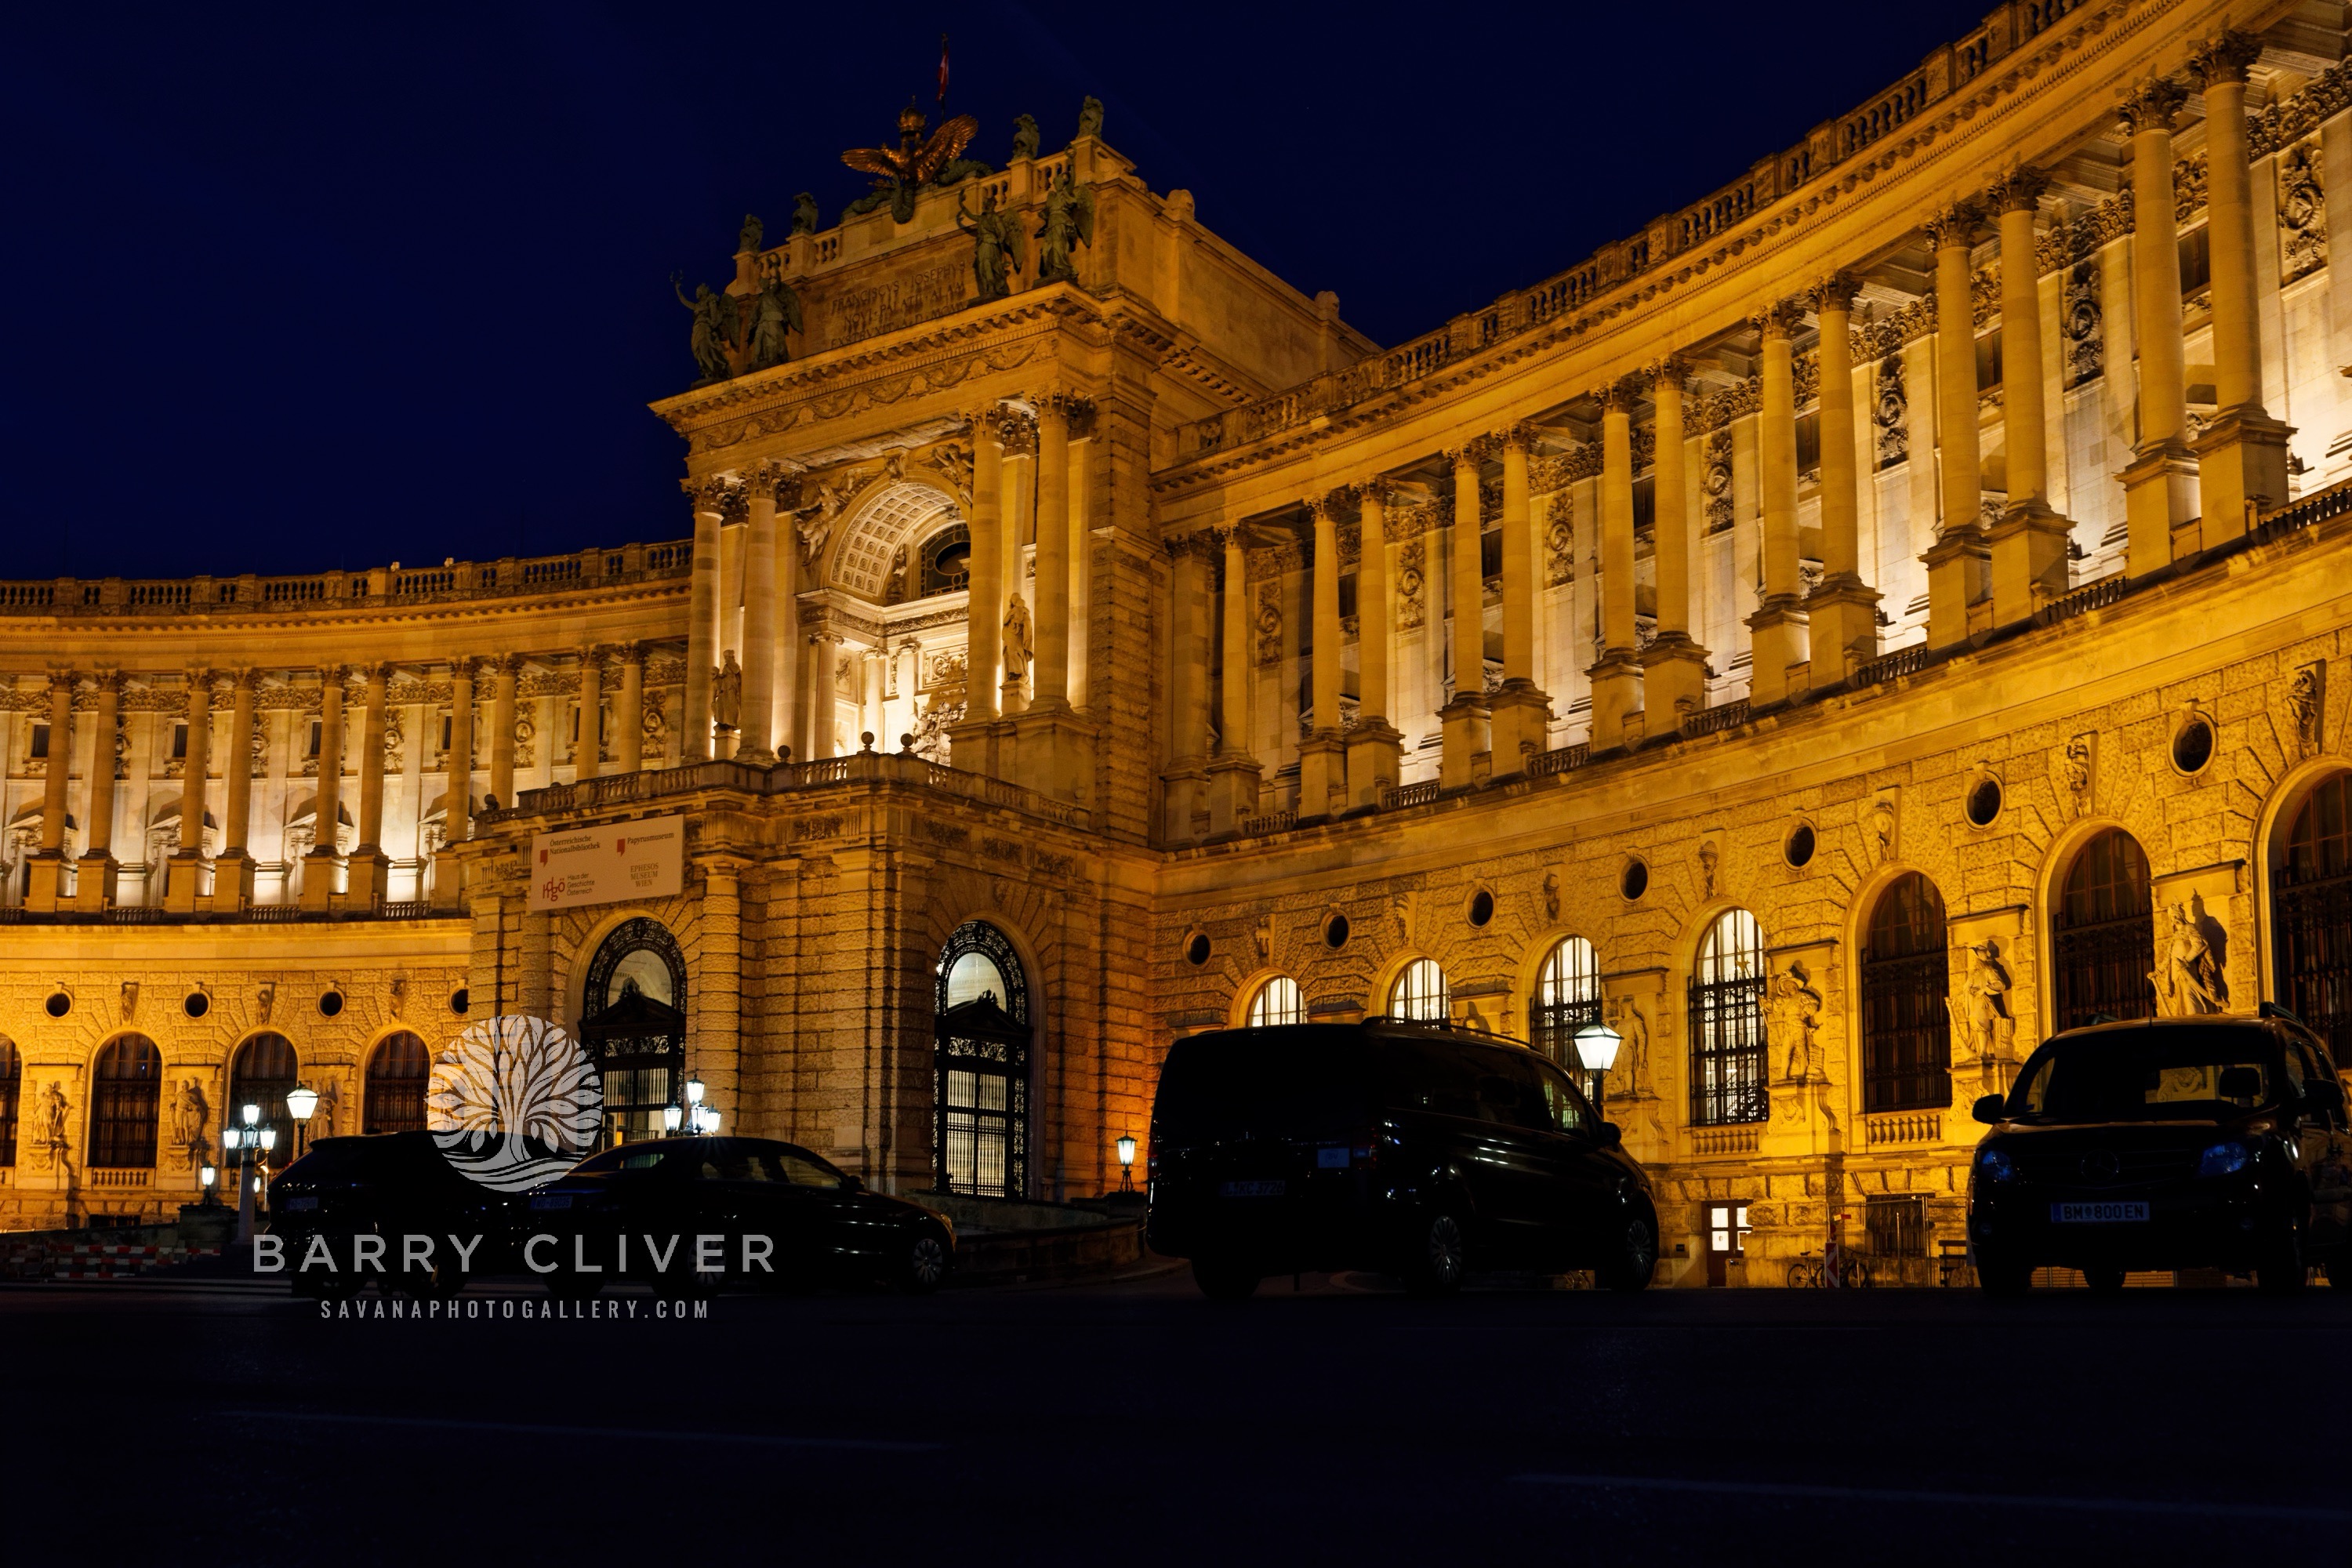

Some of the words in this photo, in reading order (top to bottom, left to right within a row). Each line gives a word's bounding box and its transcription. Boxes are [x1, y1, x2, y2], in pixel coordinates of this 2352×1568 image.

[550, 835, 592, 847] Österreichische
[627, 833, 674, 845] Papyrusmuseum
[550, 842, 601, 855] Nationalbibliothek
[630, 862, 659, 873] EPHESOS
[630, 871, 658, 880] MUSEUM
[1256, 1182, 1283, 1194] 3726
